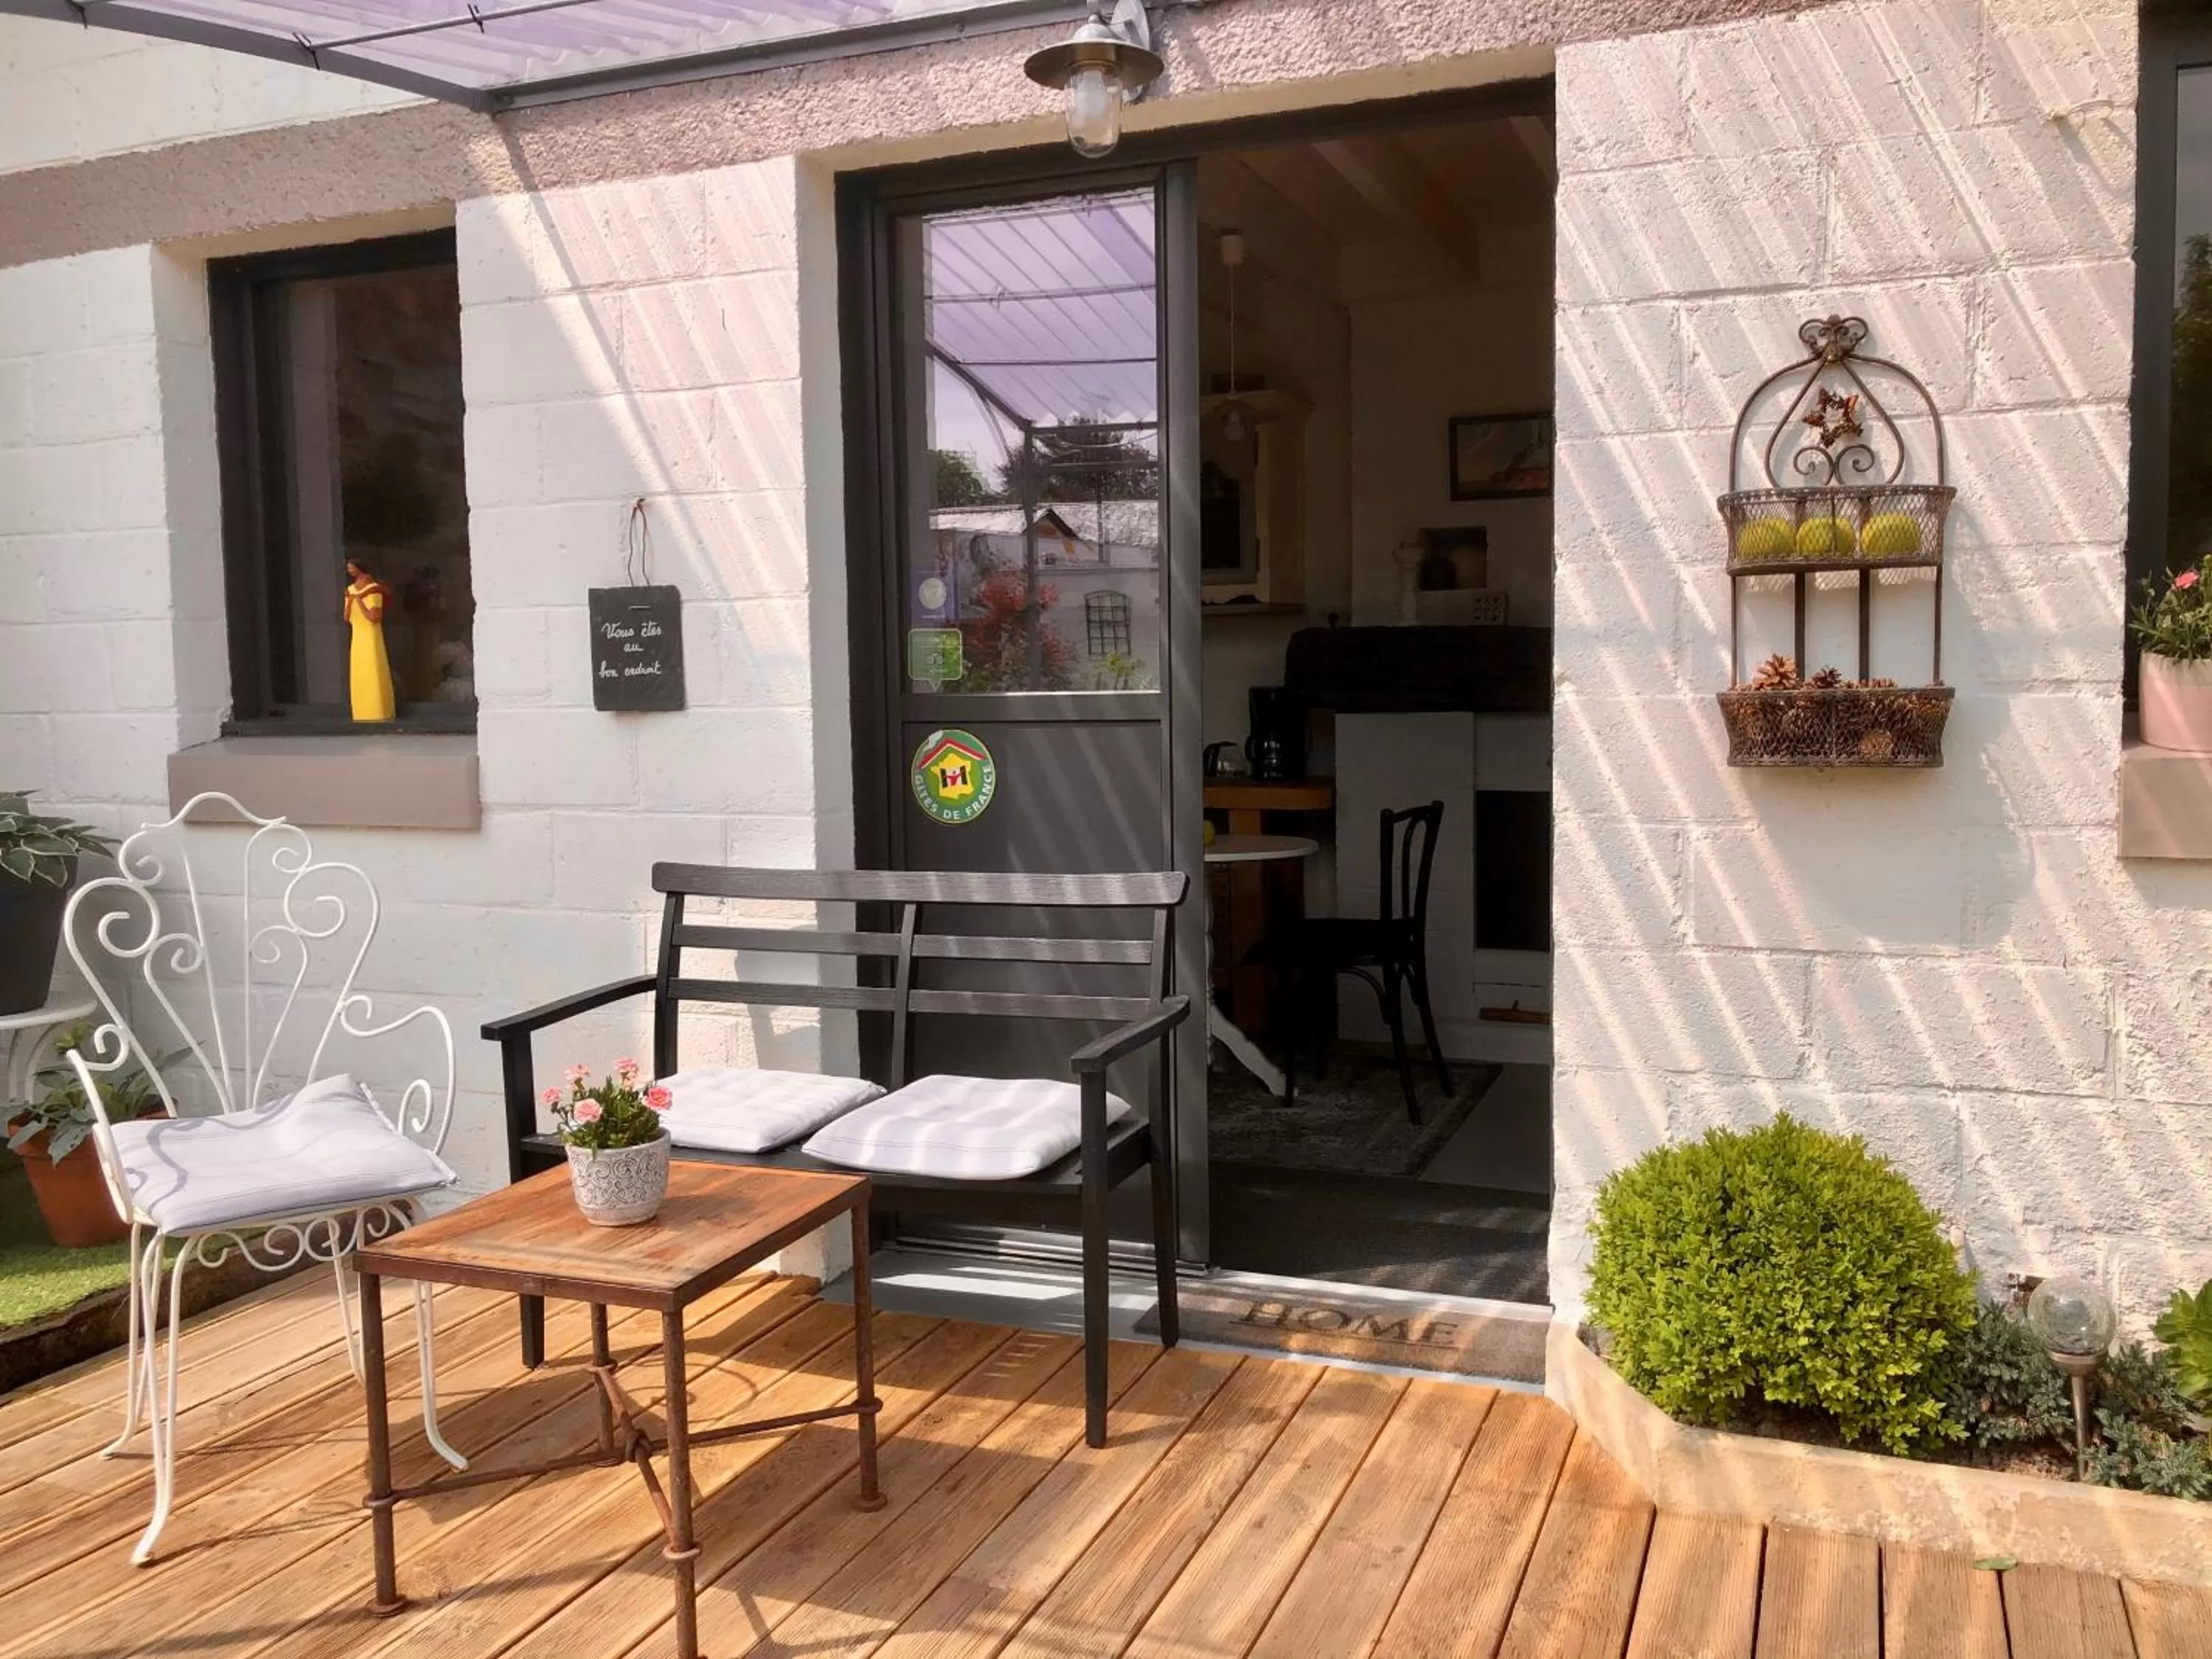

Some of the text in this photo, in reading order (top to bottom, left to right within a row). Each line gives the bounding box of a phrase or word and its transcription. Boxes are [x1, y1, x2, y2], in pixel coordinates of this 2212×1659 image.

[602, 622, 635, 639] Vous
[623, 642, 644, 652] au
[598, 661, 661, 678] bon endroit
[943, 810, 960, 820] DE
[965, 764, 992, 816] FRANCE
[1239, 1302, 1459, 1344] HOME
